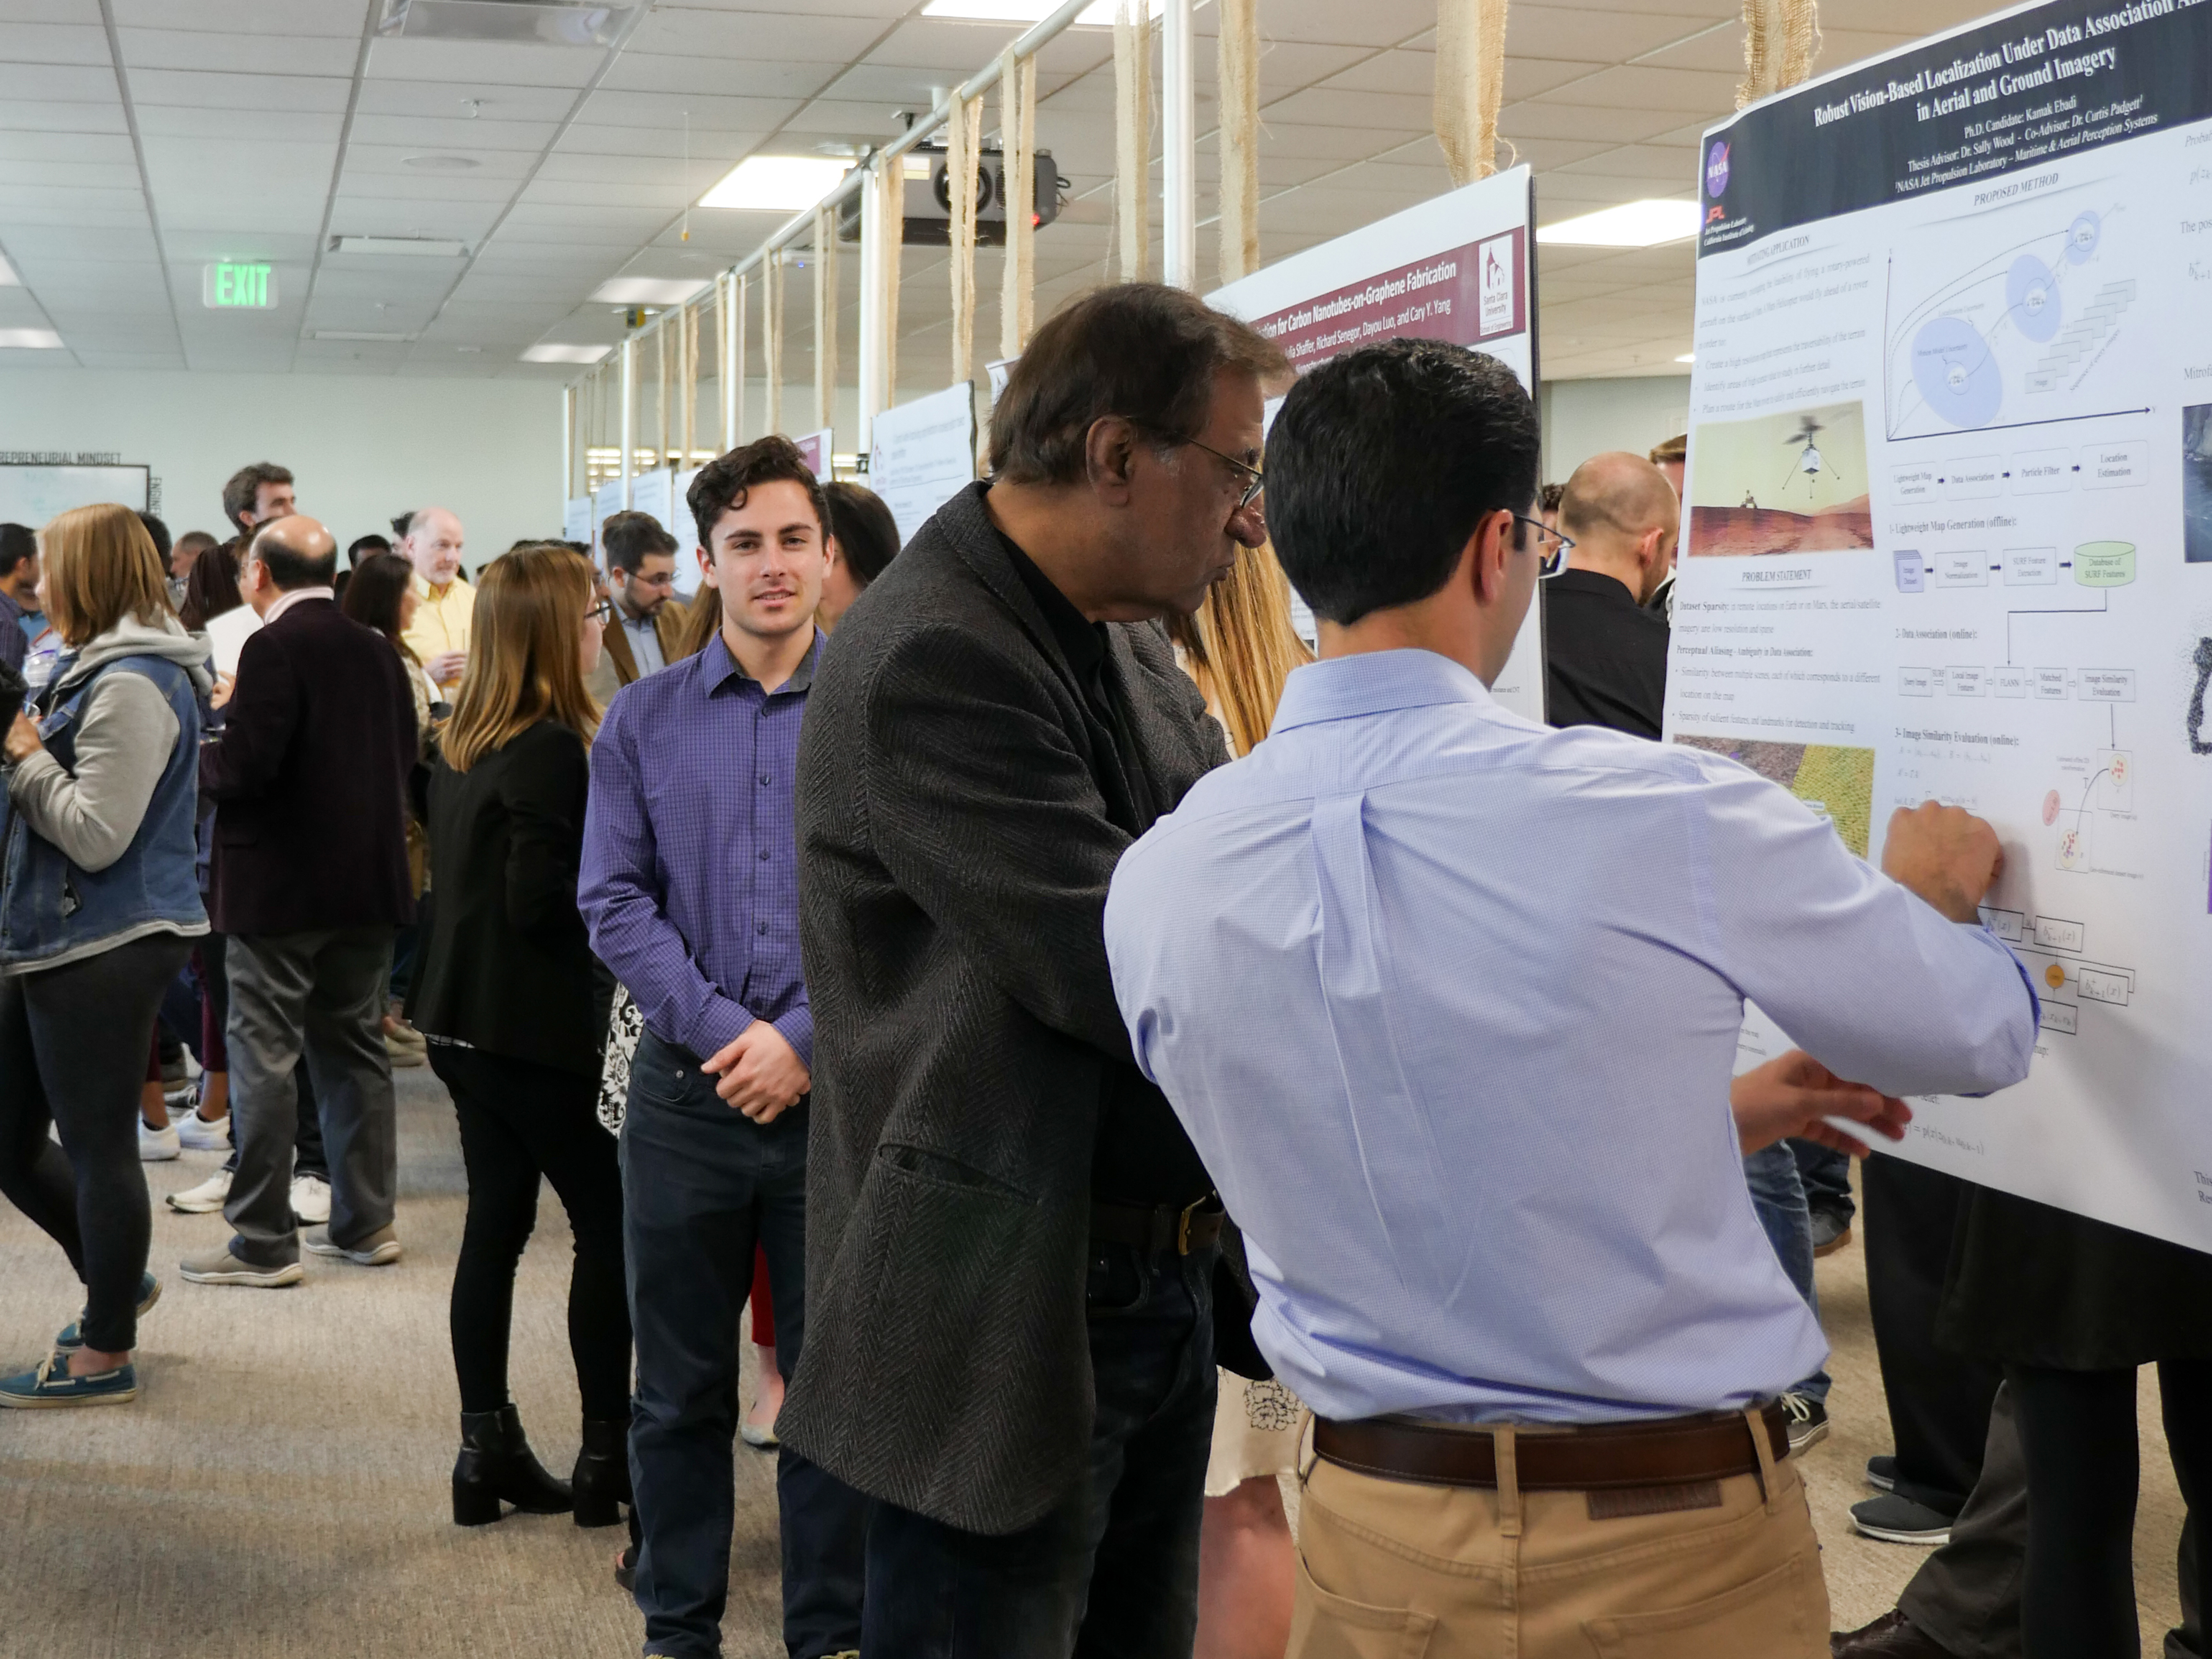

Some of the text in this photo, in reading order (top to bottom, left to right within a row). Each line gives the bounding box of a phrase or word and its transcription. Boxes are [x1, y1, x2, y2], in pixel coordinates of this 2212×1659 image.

[1814, 0, 2174, 127] Robust Vision-Based Localization Under Data Association
[1917, 47, 2116, 122] in Aerial and Ground Imagery
[1964, 95, 2077, 139] Ph.D. Candidate: Kamak Ebadi
[1908, 157, 1930, 172] Thesis
[1930, 151, 1960, 167] Advisor:
[1960, 146, 1972, 158] Dr.
[1973, 140, 1991, 155] Sally
[1993, 132, 2014, 149] Wood
[2025, 120, 2070, 141] Co-Advisor:
[2072, 115, 2083, 128] Dr.
[2085, 106, 2109, 123] Curtis
[1920, 174, 1930, 187] Jet
[1931, 167, 1967, 184] Propulsion
[1969, 156, 2008, 175] Laboratory
[2015, 145, 2047, 162] Maritime
[2048, 140, 2056, 152] &
[2057, 133, 2080, 150] Aerial
[2082, 123, 2123, 143] Perception
[2124, 114, 2158, 133] Systems
[1708, 161, 1728, 179] NASA
[1974, 173, 2058, 206] PROPOSED METHOD
[2180, 221, 2196, 233] The
[1770, 235, 1809, 256] APPLICATION
[1827, 253, 1870, 272] rotary-powered
[217, 264, 271, 306] EXIT
[1277, 261, 1456, 336] for Carbon Nanotubes-on-Graphene Fabrication
[1484, 292, 1507, 305] Santa Clara
[1485, 303, 1506, 316] University
[1296, 339, 1316, 357] Shaffer,
[1316, 331, 1336, 350] Richard
[1337, 326, 1362, 344] Senegor,
[1363, 320, 1382, 337] Dayou
[1382, 315, 1396, 330] Luo,
[1397, 308, 1409, 326] and
[1410, 306, 1425, 322] Cary
[1426, 301, 1433, 317] Y.
[1433, 299, 1451, 315] Yang
[77, 452, 121, 464] MINDSET
[2100, 453, 2128, 463] Location
[1966, 472, 1995, 482] Association
[2021, 467, 2060, 478] Particle Filter
[2097, 467, 2131, 478] Estimation
[1900, 485, 1925, 495] Generation
[1896, 521, 1929, 536] Lightweight
[1931, 520, 1945, 533] Map
[1947, 518, 1985, 530] Generation
[2089, 557, 2121, 567] Database of
[1742, 569, 1812, 582] PROBLEM STATEMENT
[2085, 570, 2126, 578] SURF Features
[1680, 601, 1700, 611] Dataset
[1902, 628, 1913, 639] Data
[1915, 629, 1947, 639] Association
[1677, 645, 1708, 656] Perceptual
[1709, 646, 1733, 656] Aliasing
[1681, 666, 1709, 679] Similarity
[1711, 668, 1733, 678] between
[2084, 674, 2128, 685] Image Similarity
[1680, 689, 1702, 699] location
[2092, 687, 2121, 697] Evaluation
[1679, 711, 1700, 723] Sparsity
[1903, 728, 1922, 742] Image
[1922, 729, 1952, 744] Similarity
[1954, 732, 1988, 744] Evaluation
